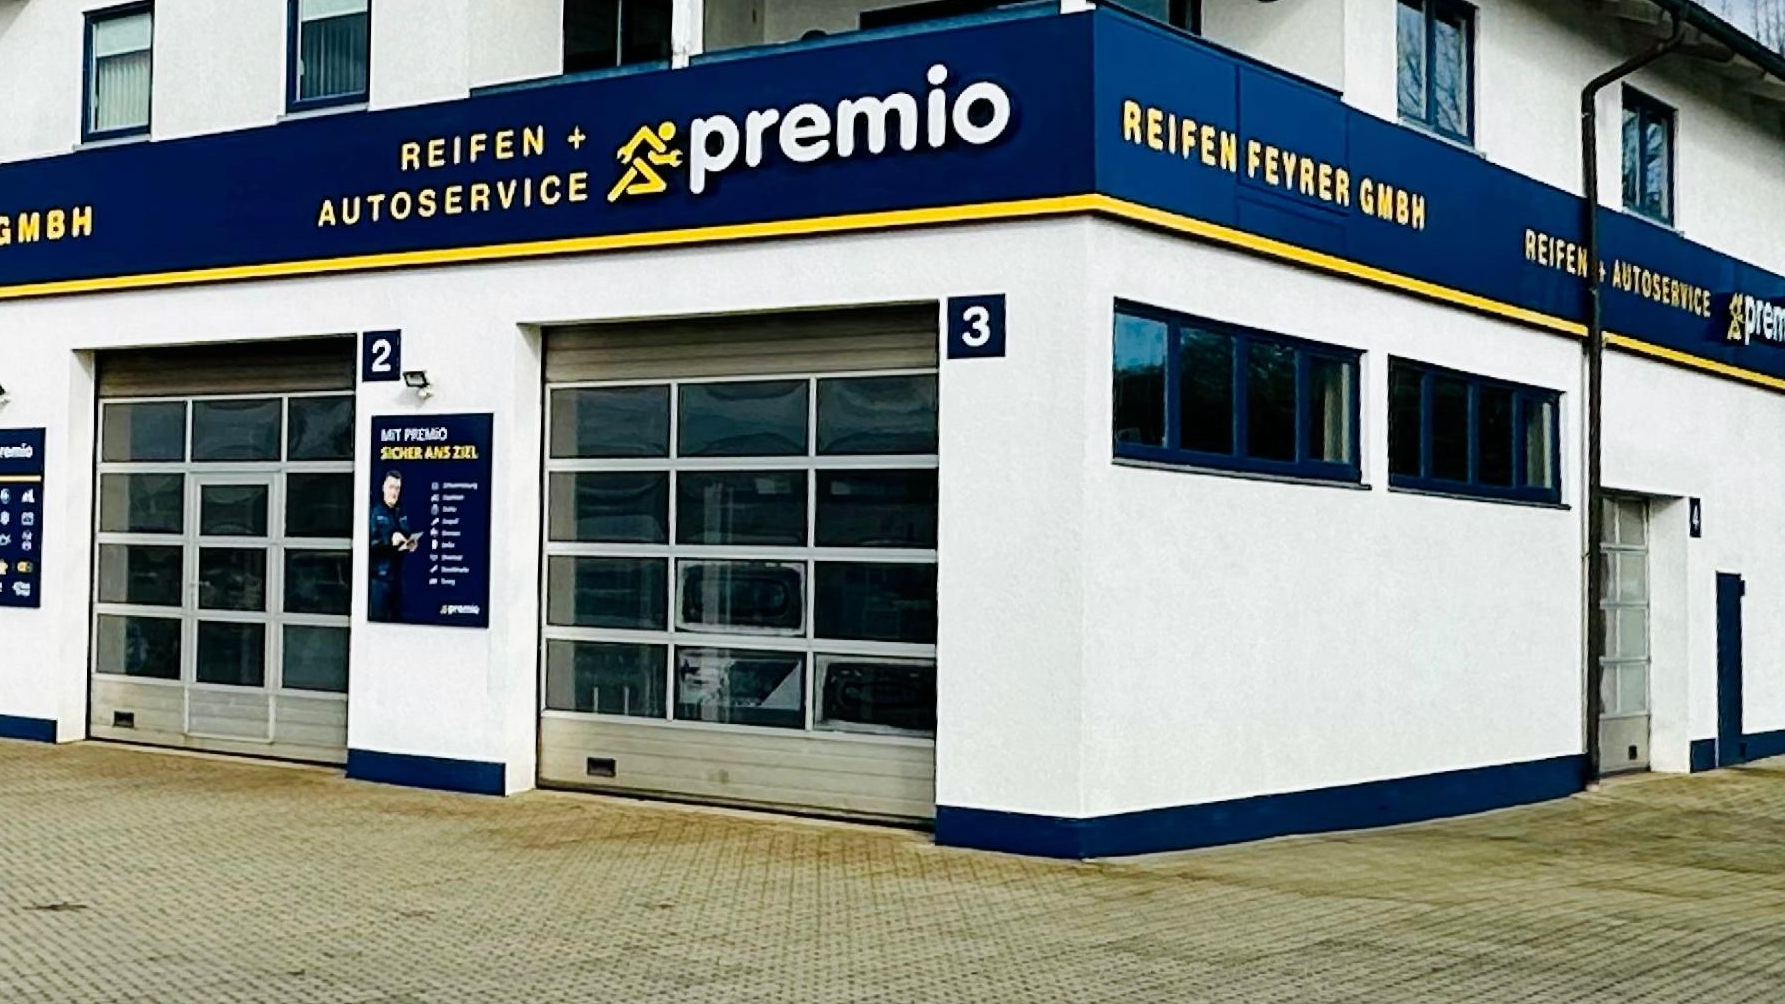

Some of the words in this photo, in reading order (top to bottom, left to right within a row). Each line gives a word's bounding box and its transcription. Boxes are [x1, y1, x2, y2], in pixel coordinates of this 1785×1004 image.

[401, 125, 544, 171] REIFEN
[567, 126, 586, 149] +
[689, 63, 1012, 195] premio
[1123, 99, 1238, 174] REIFEN
[1247, 139, 1351, 207] FEYRER
[1359, 178, 1426, 231] GMBH
[318, 171, 589, 227] AUTOSERVICE
[1525, 228, 1588, 278] REIFEN
[1612, 259, 1712, 318] AUTOSERVICE
[961, 306, 991, 347] 3
[371, 338, 392, 372] 2
